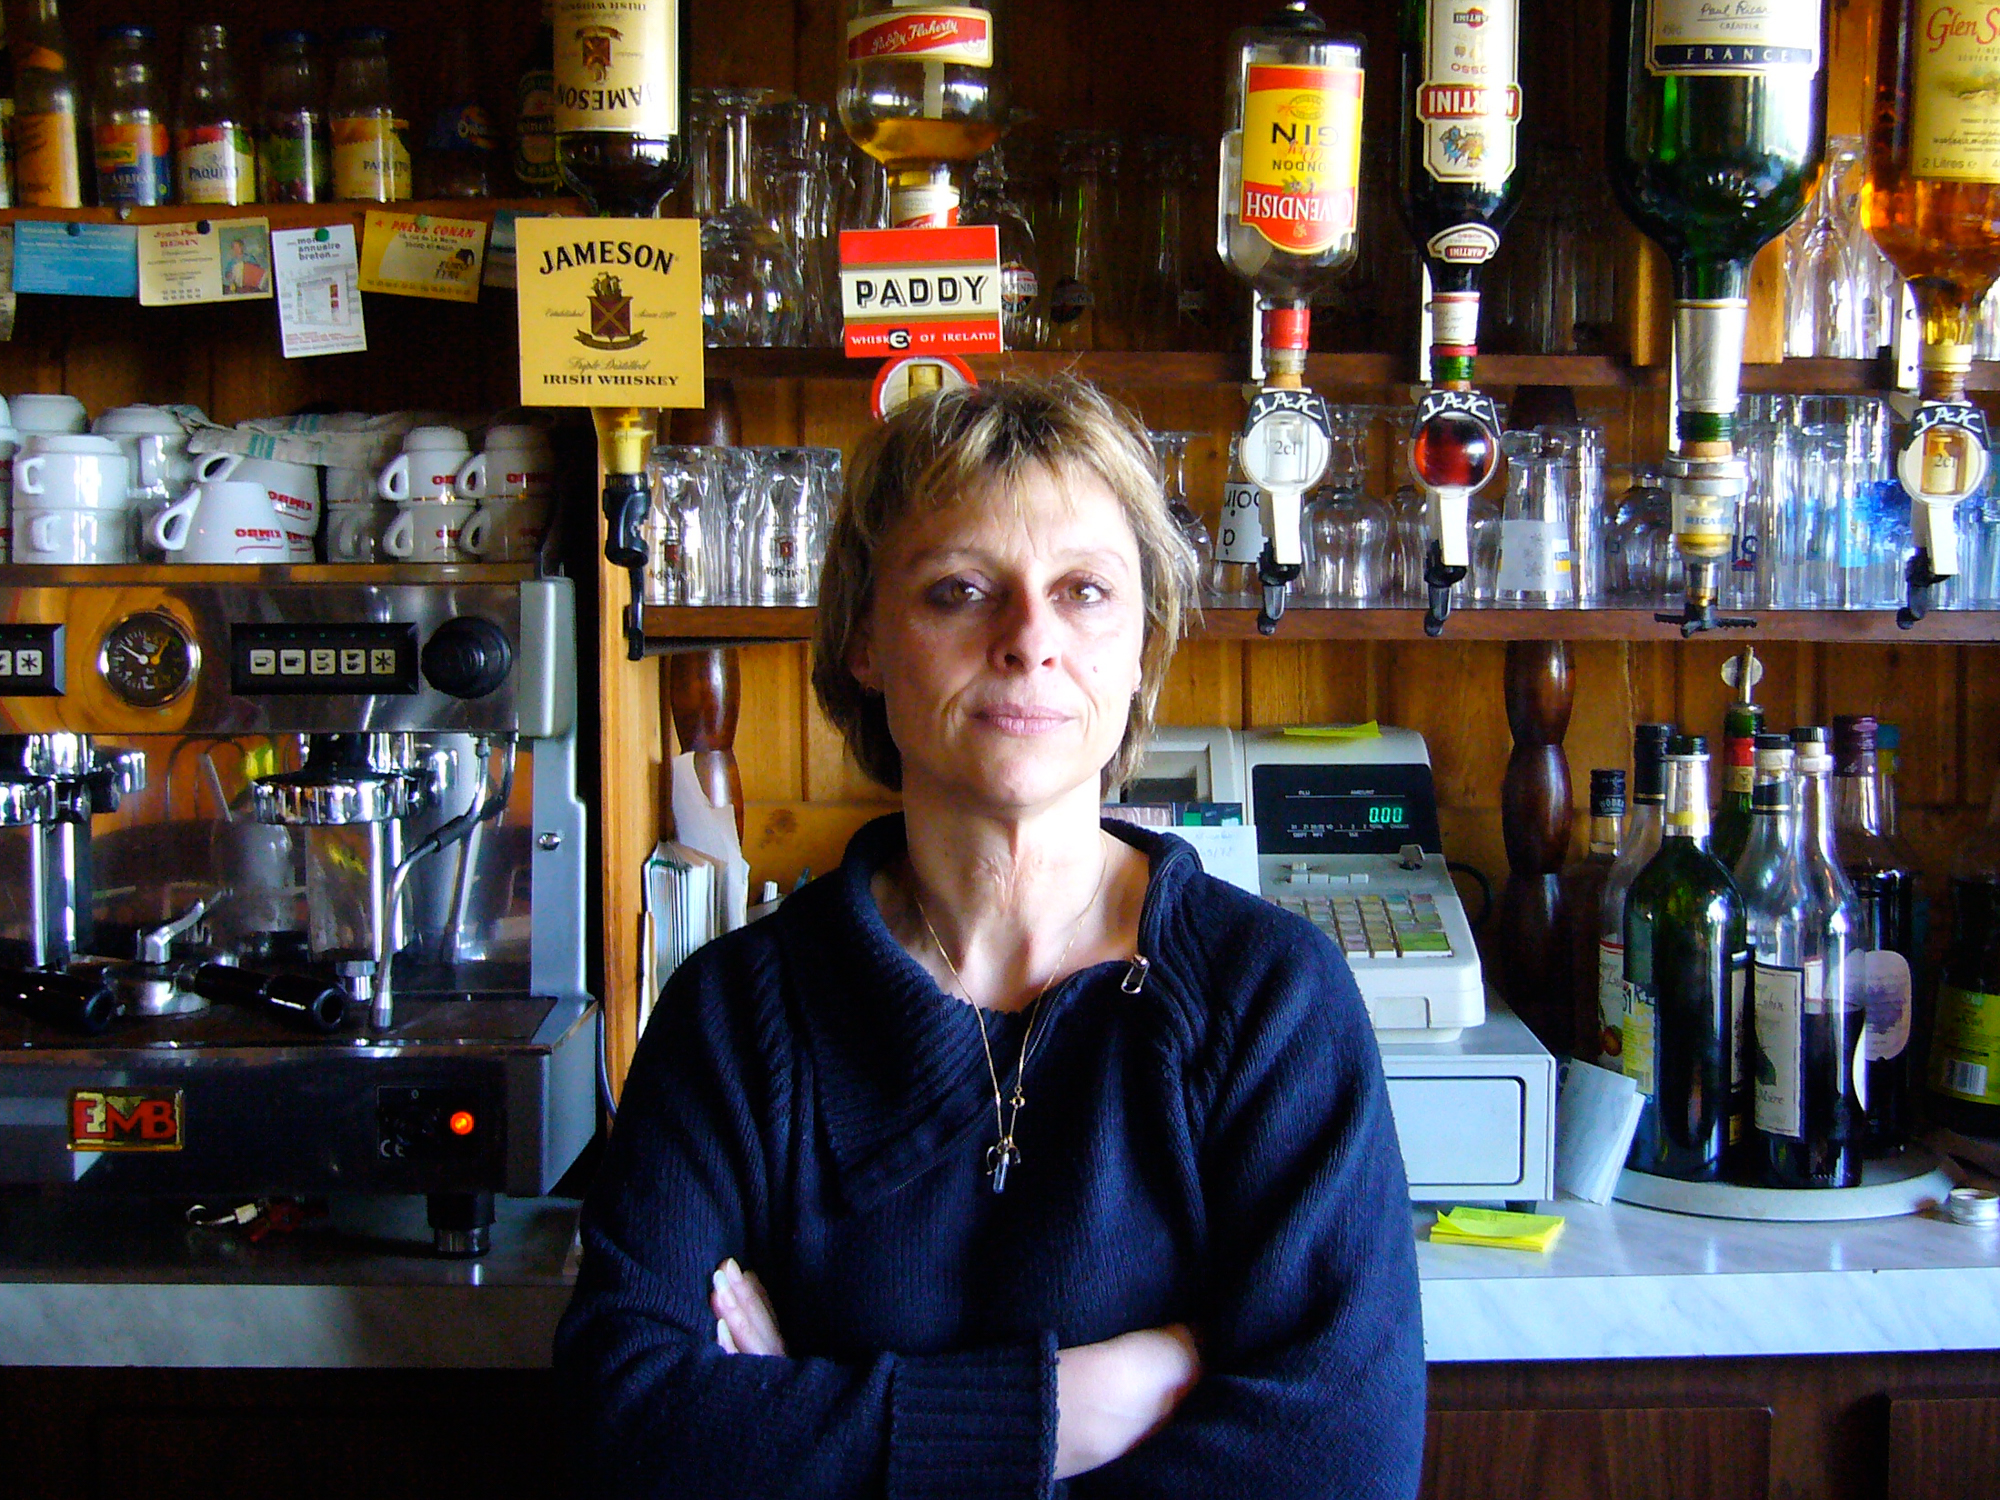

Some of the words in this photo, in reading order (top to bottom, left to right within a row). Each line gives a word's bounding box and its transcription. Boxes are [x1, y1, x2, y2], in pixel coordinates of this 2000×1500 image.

[1926, 6, 1977, 53] Glen
[1686, 48, 1789, 62] FRANCE
[1246, 190, 1353, 228] CAVENDISH
[539, 240, 674, 275] JAMESON
[856, 276, 988, 309] PADDY
[920, 333, 936, 342] OF
[943, 332, 996, 342] IRELAND
[543, 374, 592, 385] IRISH
[598, 375, 678, 387] WHISKEY
[1273, 440, 1297, 455] 2cl
[268, 491, 313, 512] KIMBO
[234, 528, 283, 539] KIMBO
[73, 1099, 177, 1140] EMB
